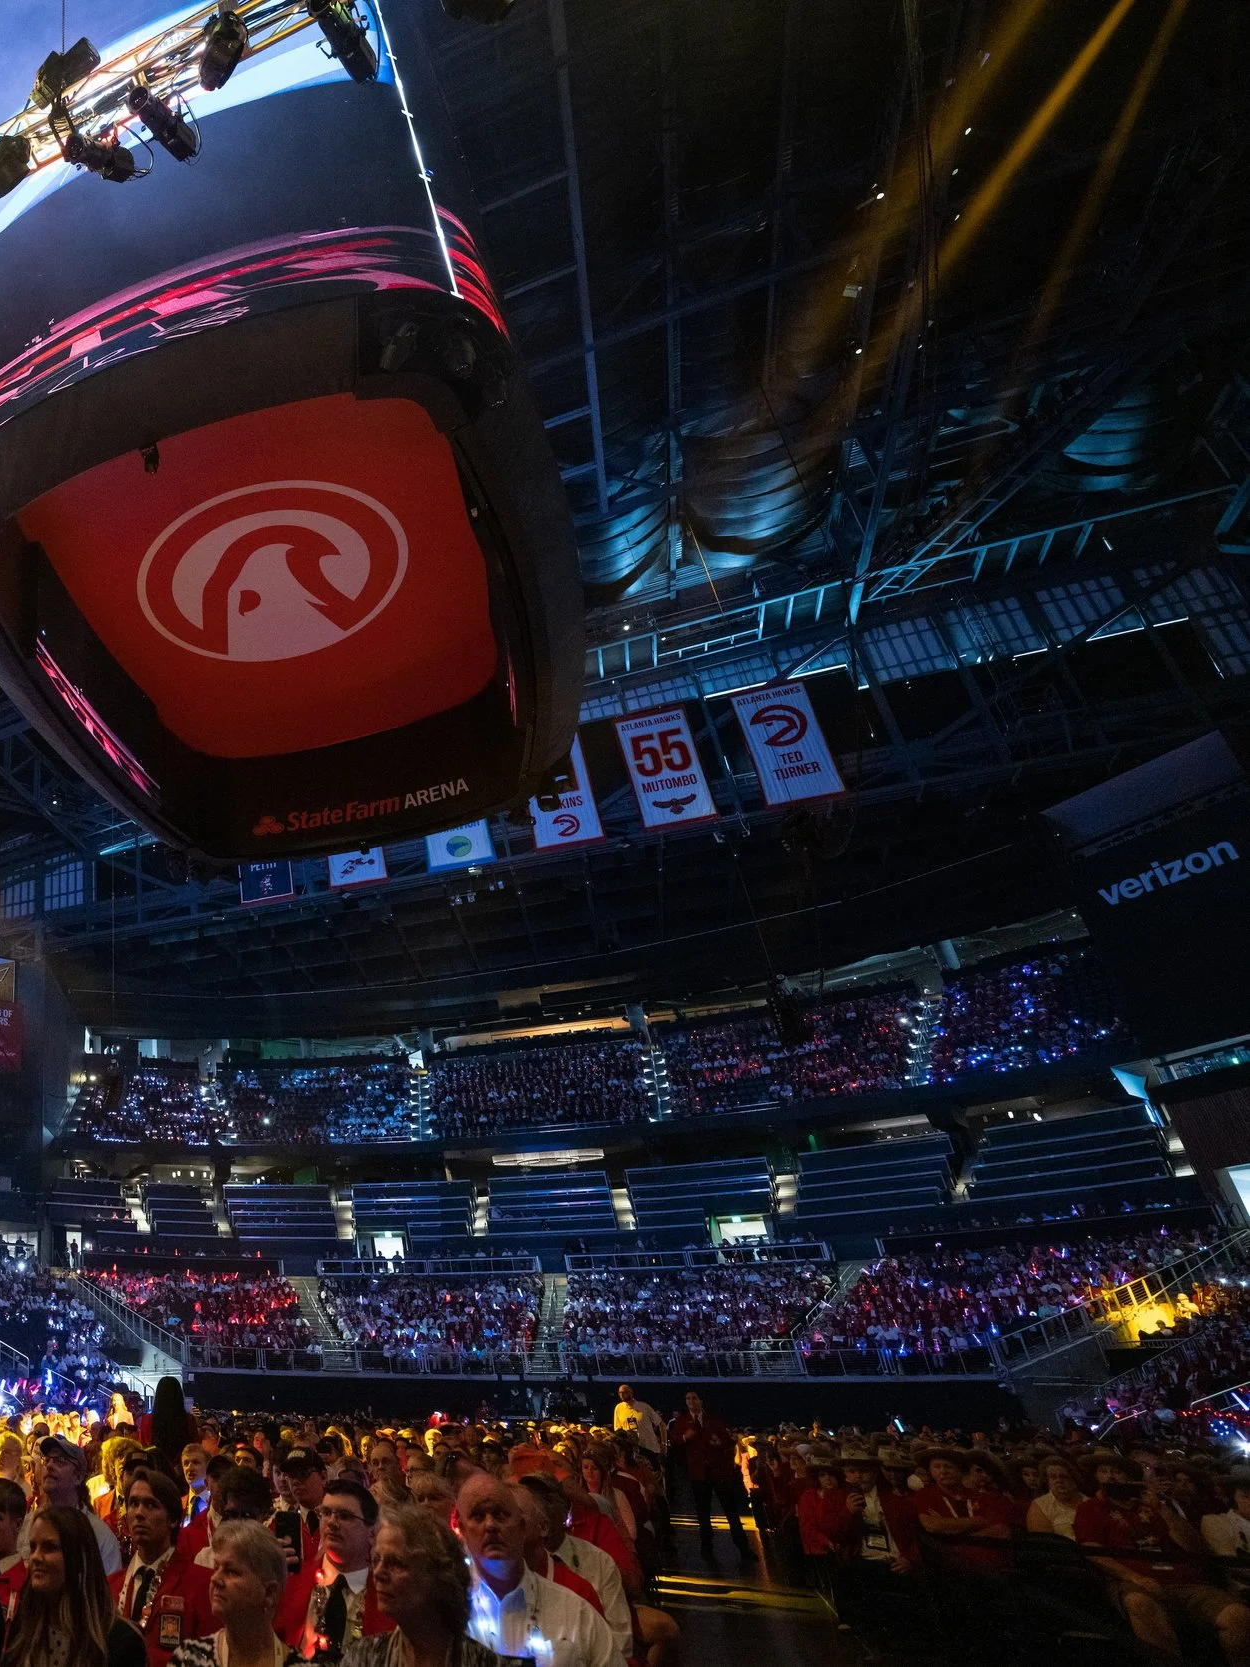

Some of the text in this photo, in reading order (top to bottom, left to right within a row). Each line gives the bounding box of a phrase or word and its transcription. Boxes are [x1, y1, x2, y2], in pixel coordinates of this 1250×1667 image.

[737, 686, 801, 706] ATLANTA HAWKS
[621, 713, 681, 732] ATLANTA HAWKS
[630, 727, 692, 778] 55
[779, 751, 803, 765] TED
[773, 761, 822, 780] TURNER
[404, 778, 469, 809] ARENA
[642, 773, 698, 794] MUTOMBO
[1097, 840, 1240, 907] verizon
[2, 1009, 14, 1018] OF
